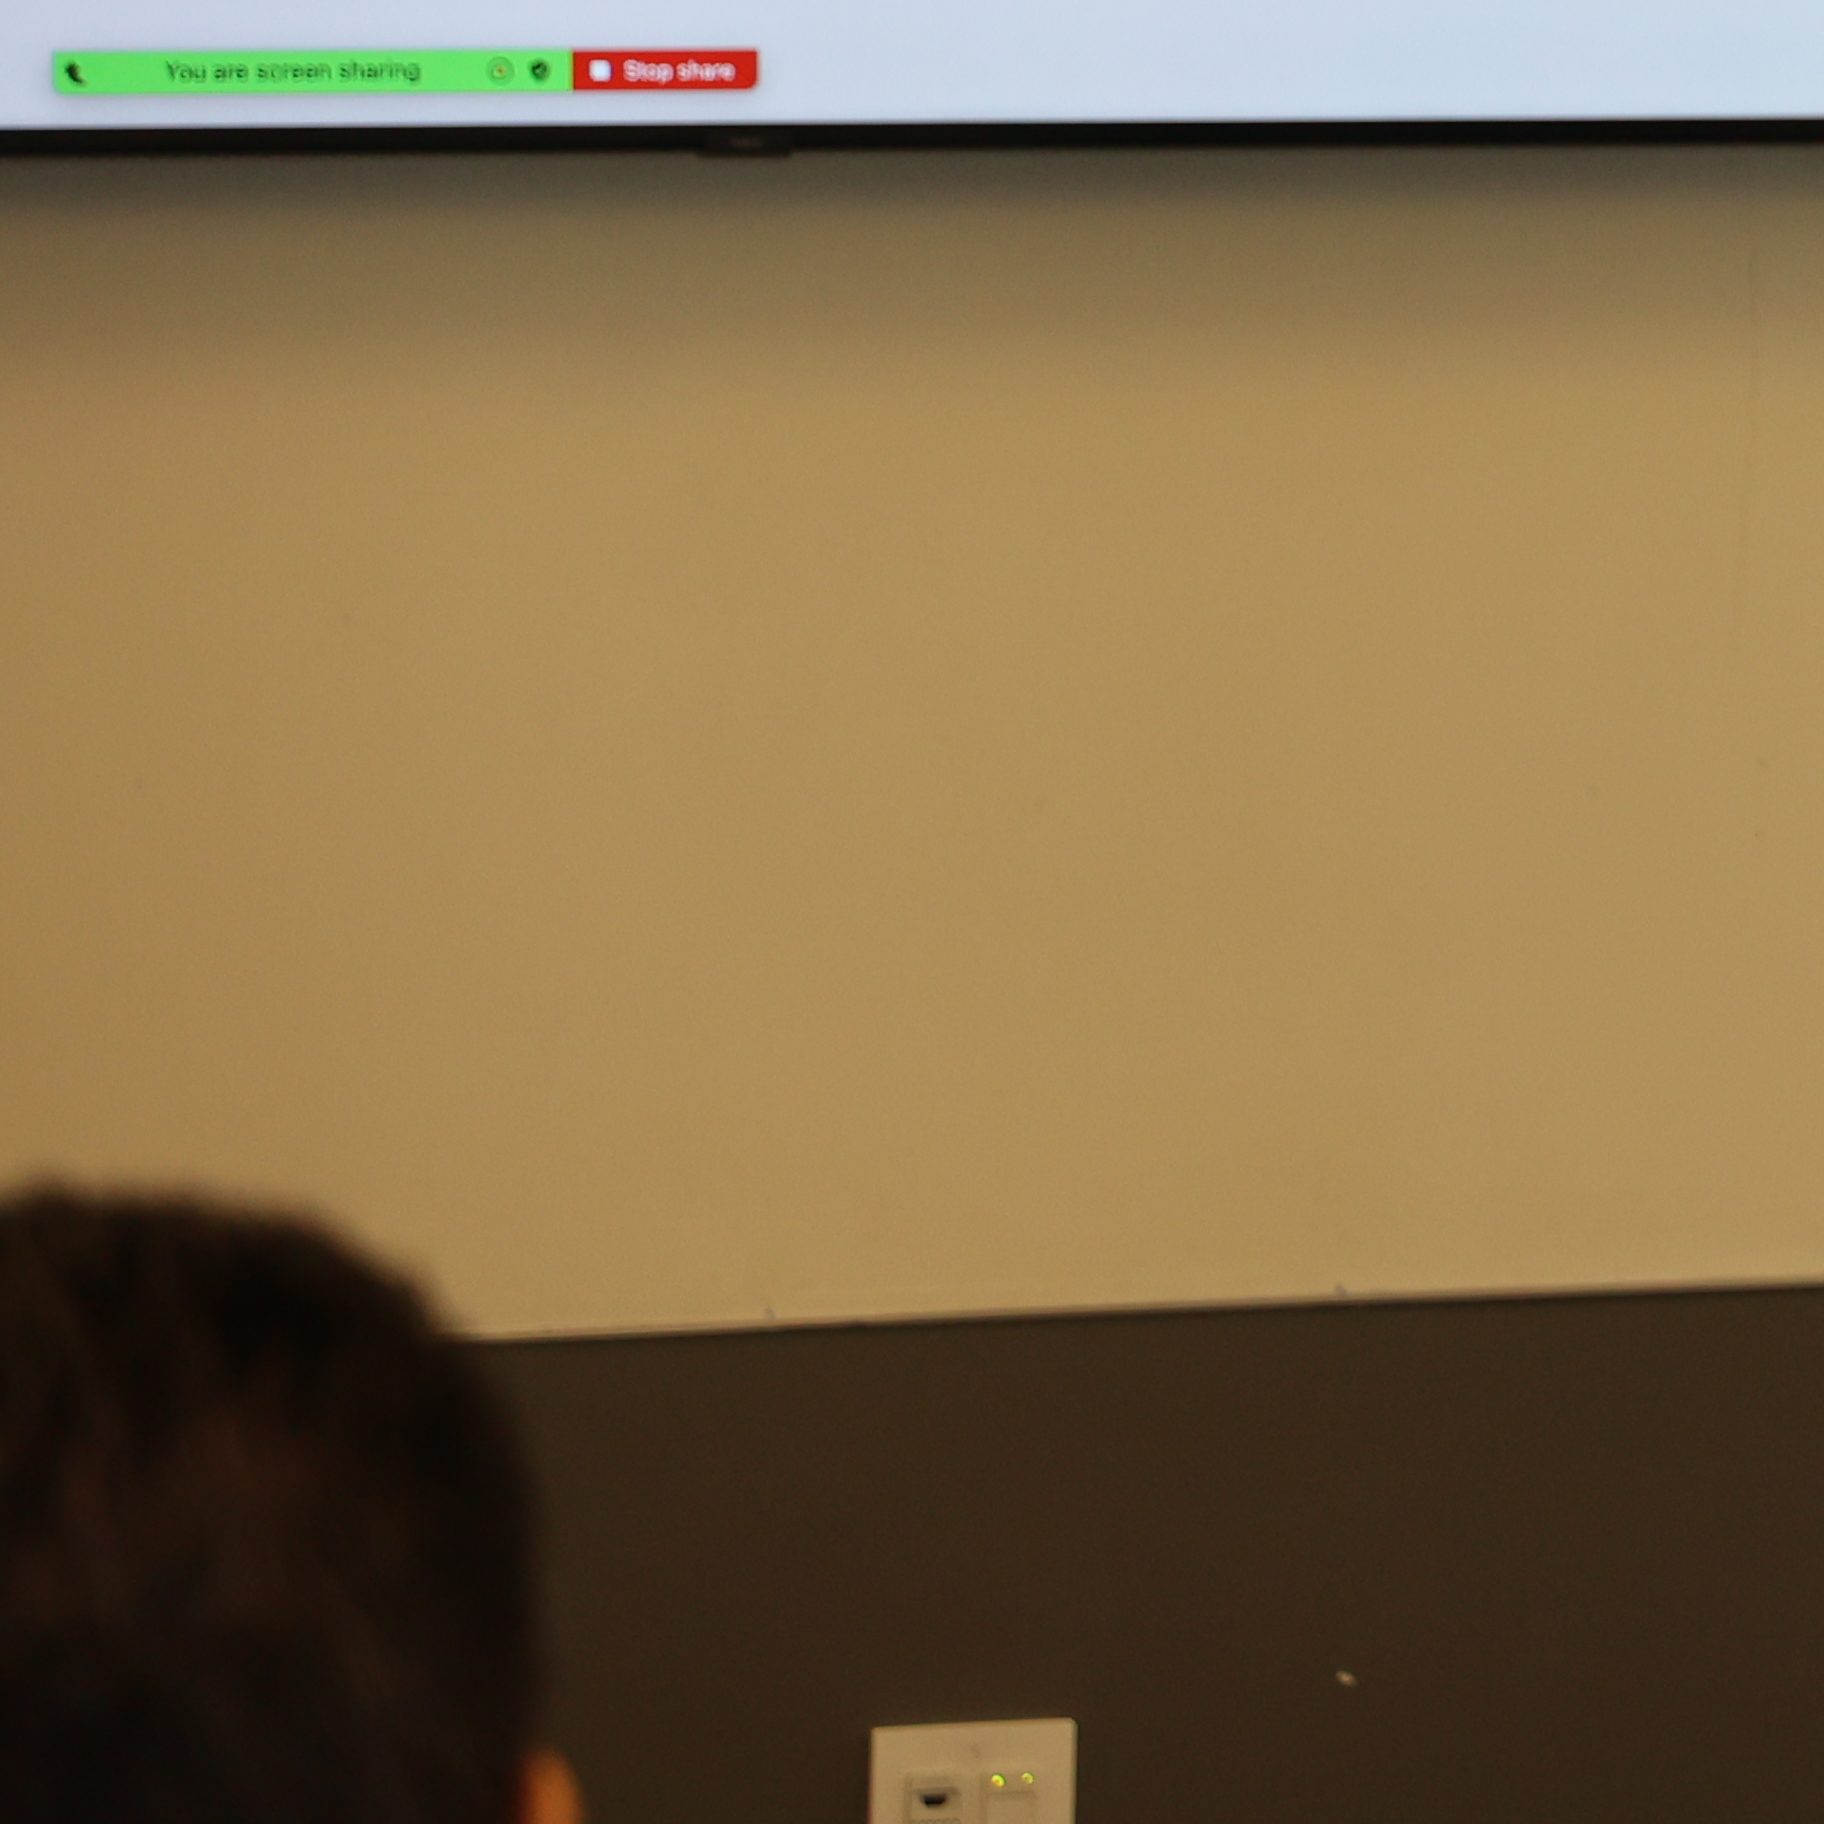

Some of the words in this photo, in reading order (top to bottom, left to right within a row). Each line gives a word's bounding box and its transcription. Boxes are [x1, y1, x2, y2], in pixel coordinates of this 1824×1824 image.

[165, 59, 207, 83] You
[214, 63, 249, 83] are
[256, 62, 332, 83] screen
[339, 59, 422, 86] sharing
[622, 58, 675, 85] Stop
[675, 58, 737, 83] share
